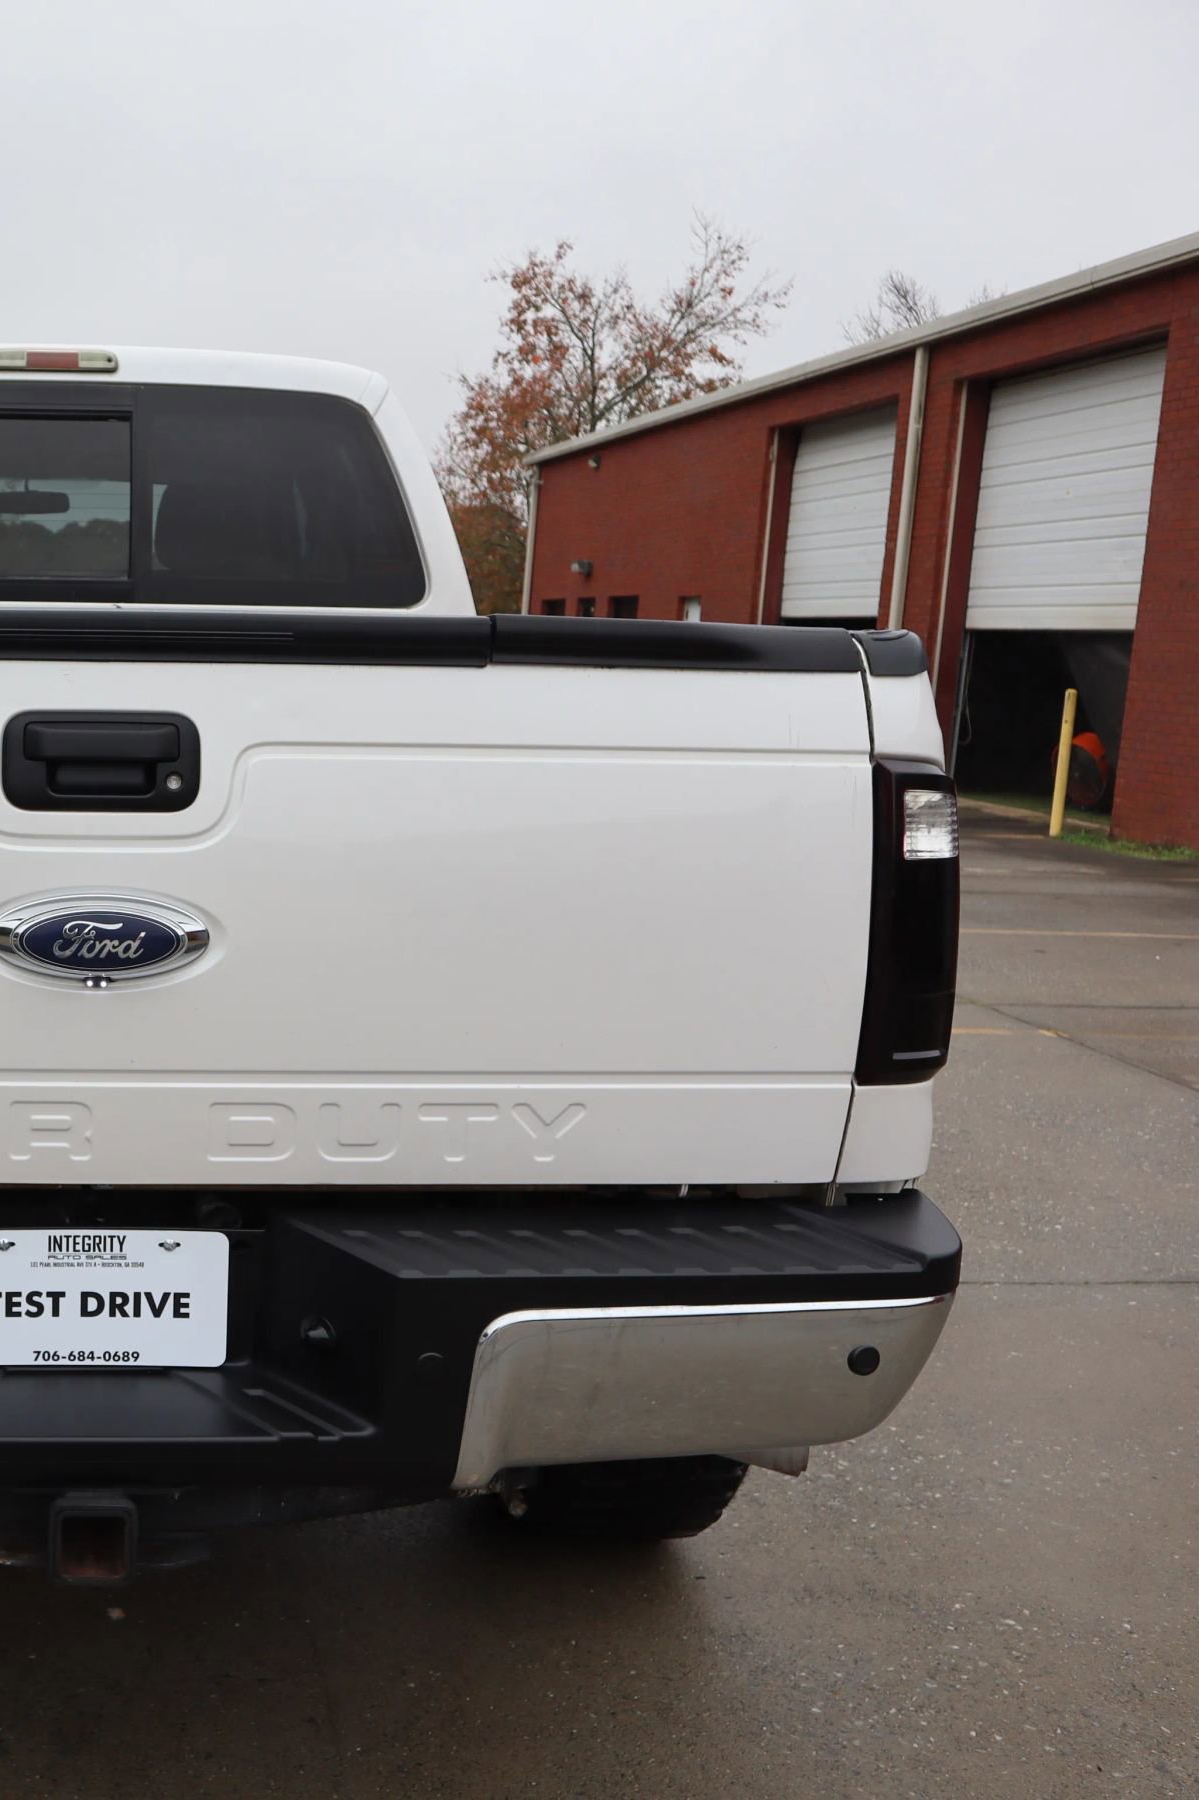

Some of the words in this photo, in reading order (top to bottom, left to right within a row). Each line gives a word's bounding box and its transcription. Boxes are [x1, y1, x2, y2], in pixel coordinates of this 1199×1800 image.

[53, 920, 146, 960] Ford
[207, 1101, 588, 1163] DUTY
[48, 1235, 127, 1253] INTEGRITY
[80, 1291, 191, 1319] DRIVE
[32, 1350, 140, 1363] 706-684-0689
